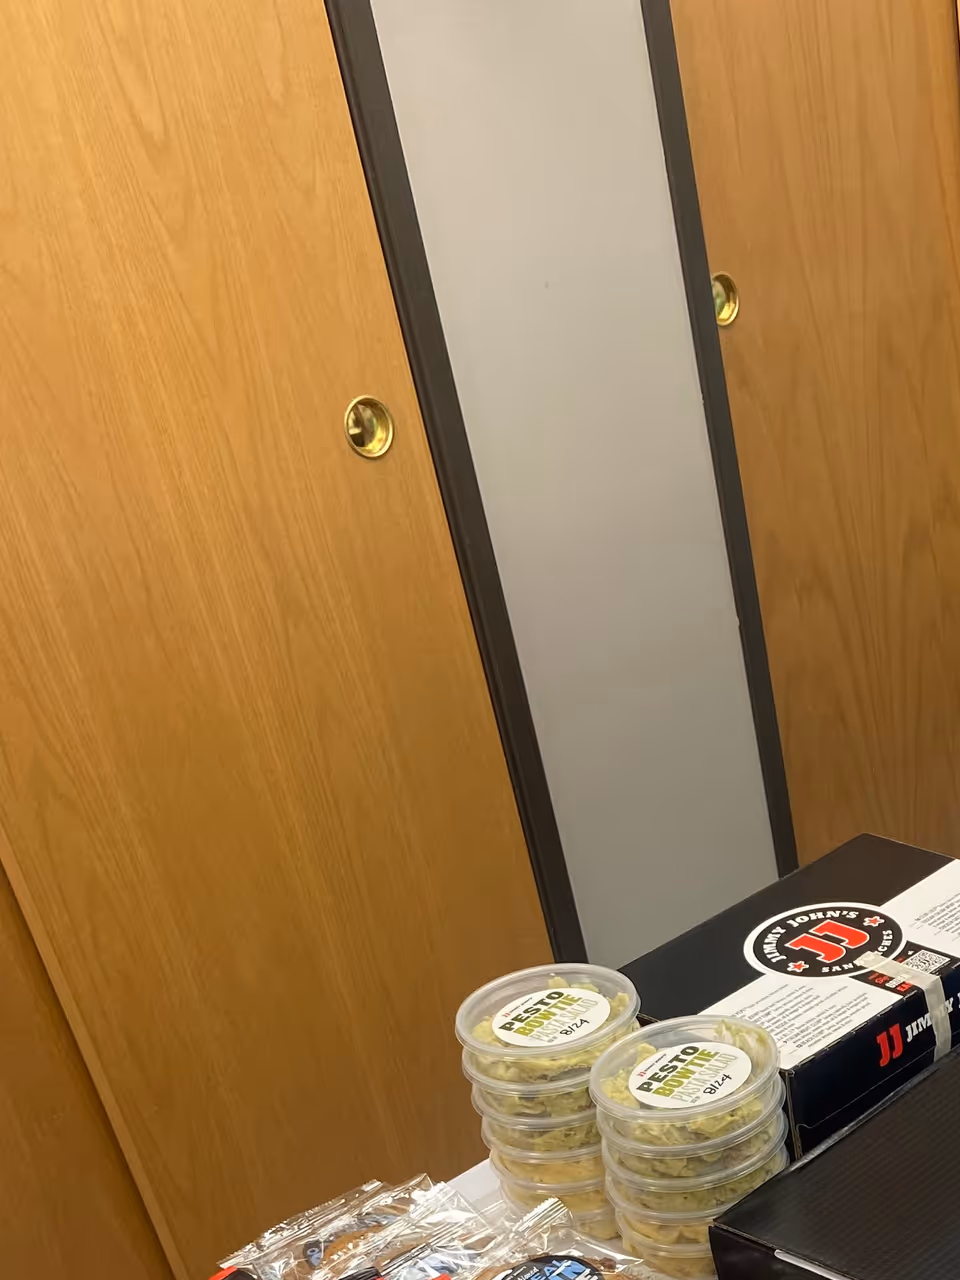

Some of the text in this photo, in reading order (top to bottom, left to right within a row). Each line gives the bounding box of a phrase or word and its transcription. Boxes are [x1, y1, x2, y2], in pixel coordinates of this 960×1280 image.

[762, 910, 859, 963] JIMMY JOHN'S
[784, 919, 870, 964] JJ
[499, 991, 564, 1032] PESTO
[513, 994, 583, 1037] BOWTIE
[559, 1019, 589, 1036] 8/24
[876, 1023, 904, 1067] JJ
[636, 1045, 701, 1093] PESTO
[651, 1048, 720, 1098] BOWTIE
[670, 1073, 706, 1105] PASTA
[703, 1052, 738, 1079] SALAD
[703, 1073, 733, 1096] 8/24
